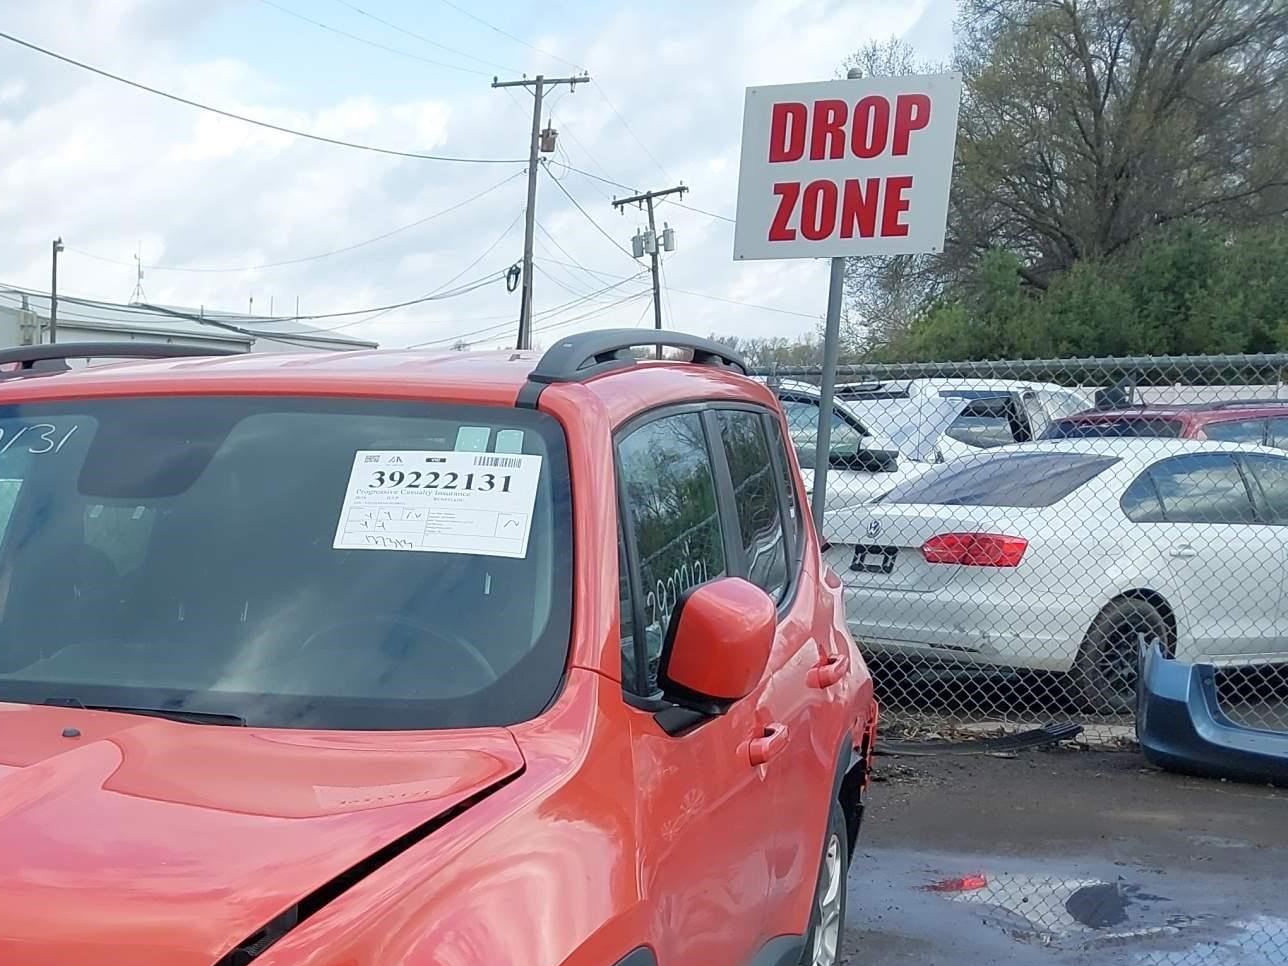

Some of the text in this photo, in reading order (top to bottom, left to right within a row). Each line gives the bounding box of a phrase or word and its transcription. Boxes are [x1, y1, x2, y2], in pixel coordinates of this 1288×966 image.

[768, 93, 931, 163] DROP
[768, 176, 913, 241] ZONE
[368, 470, 512, 493] 39222131
